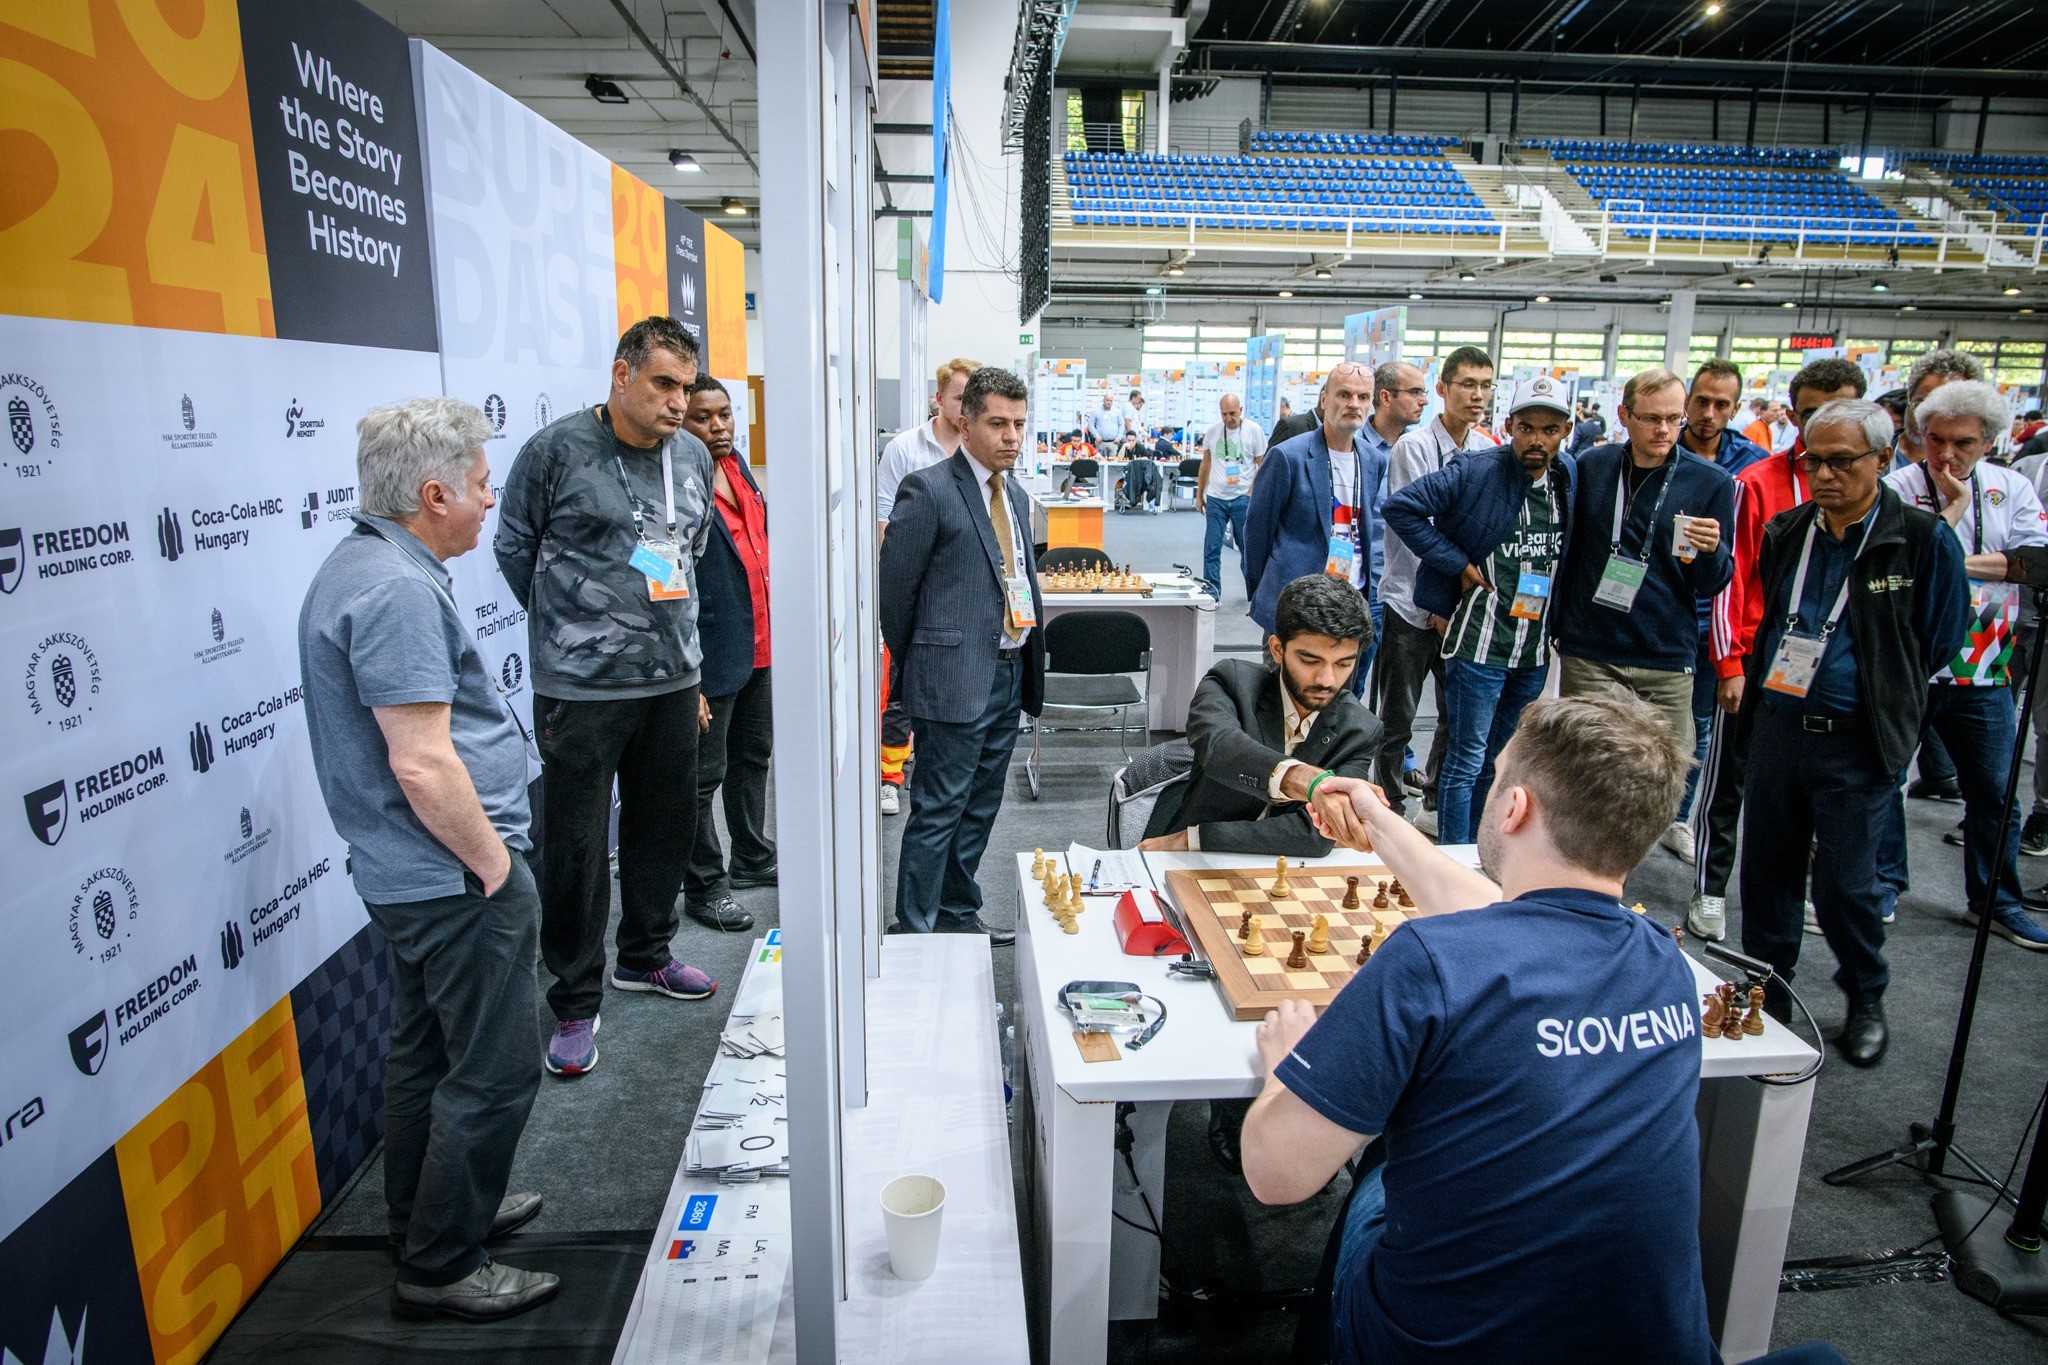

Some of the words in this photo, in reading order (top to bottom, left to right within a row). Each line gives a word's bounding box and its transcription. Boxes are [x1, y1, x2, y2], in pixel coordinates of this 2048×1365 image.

[291, 41, 384, 124] Where
[279, 95, 331, 151] the
[337, 119, 402, 185] Story
[288, 149, 408, 226] Becomes
[308, 210, 402, 278] History
[300, 418, 324, 428] SPORTOLÓ
[16, 464, 41, 477] 1921
[191, 503, 257, 527] Coca-Cola
[259, 498, 283, 517] HBC
[326, 487, 354, 504] JUDIT
[328, 508, 351, 522] CHESS
[33, 521, 130, 557] FREEDOM
[194, 529, 249, 552] Hungary
[1501, 542, 1554, 558] Viwe
[38, 557, 97, 579] HOLDING
[100, 550, 134, 568] CORP.
[475, 601, 498, 620] TECH
[476, 609, 526, 640] mahindra
[26, 653, 42, 715] MAGYAR
[59, 714, 83, 732] 1921
[221, 696, 283, 734] Coca-Cola
[224, 721, 275, 757] Hungary
[75, 746, 164, 803] FREEDOM
[80, 788, 134, 823] HOLDING
[136, 773, 168, 797] CORP.
[250, 876, 308, 926] Coca-Cola
[308, 857, 331, 885] HBC
[69, 894, 84, 955] MAGYAR
[252, 902, 301, 947] Hungary
[99, 943, 122, 964] 1921
[114, 954, 198, 1028] FREEDOM
[120, 1000, 170, 1047] HOLDING
[171, 980, 202, 1014] CORP.
[1536, 1002, 1696, 1058] SLOVENIA
[0, 1096, 45, 1148] ra
[689, 1200, 708, 1225] 2360
[745, 1204, 760, 1220] FM
[715, 1240, 732, 1257] MA
[754, 1239, 768, 1255] LA
